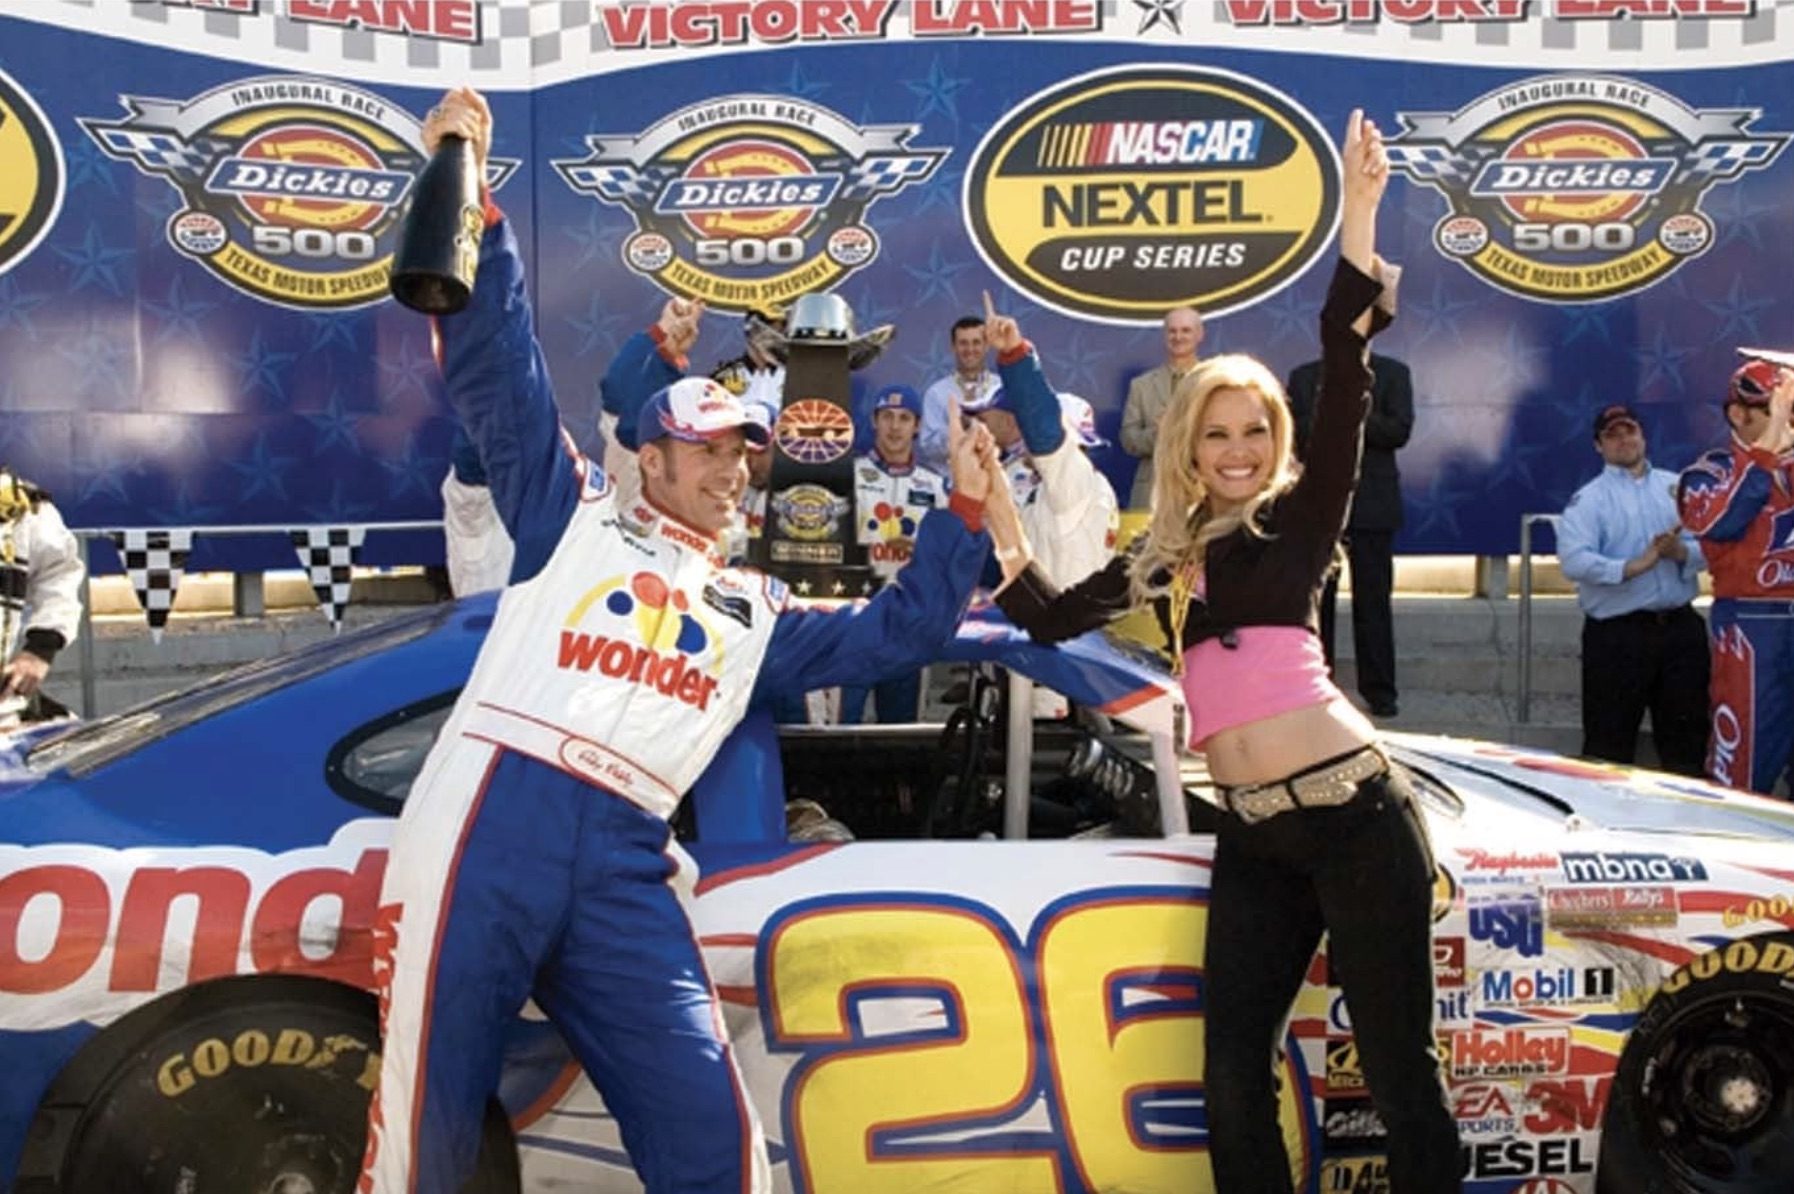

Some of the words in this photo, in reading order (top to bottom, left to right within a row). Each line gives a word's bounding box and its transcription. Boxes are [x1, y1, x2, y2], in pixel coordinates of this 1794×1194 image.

[603, 0, 882, 46] VICTORY
[914, 0, 1097, 32] LANE
[1105, 119, 1253, 164] NASCAR
[228, 164, 394, 199] Dickies
[675, 180, 822, 206] Dickies
[1491, 163, 1656, 188] Dickies
[1043, 179, 1263, 227] NEXTEL
[252, 225, 375, 260] 500
[695, 235, 804, 266] 500
[1513, 222, 1634, 250] 500
[226, 249, 271, 283] TEXAS
[273, 271, 326, 295] MOTOR
[1061, 245, 1125, 271] CUP
[1133, 243, 1246, 269] SERIES
[1486, 248, 1527, 281] TEXAS
[1530, 267, 1582, 288] MOTOR
[1585, 250, 1661, 285] SPEEDWAY
[671, 263, 712, 295] TEXAS
[761, 258, 829, 299] SPEEDWAY
[558, 631, 718, 711] wonder
[1566, 855, 1674, 881] mbna
[1483, 967, 1574, 1000] Mobil
[757, 889, 1312, 1194] 26
[1454, 1030, 1566, 1073] Holley
[1455, 1086, 1514, 1118] EA
[1525, 1079, 1613, 1134] 3M
